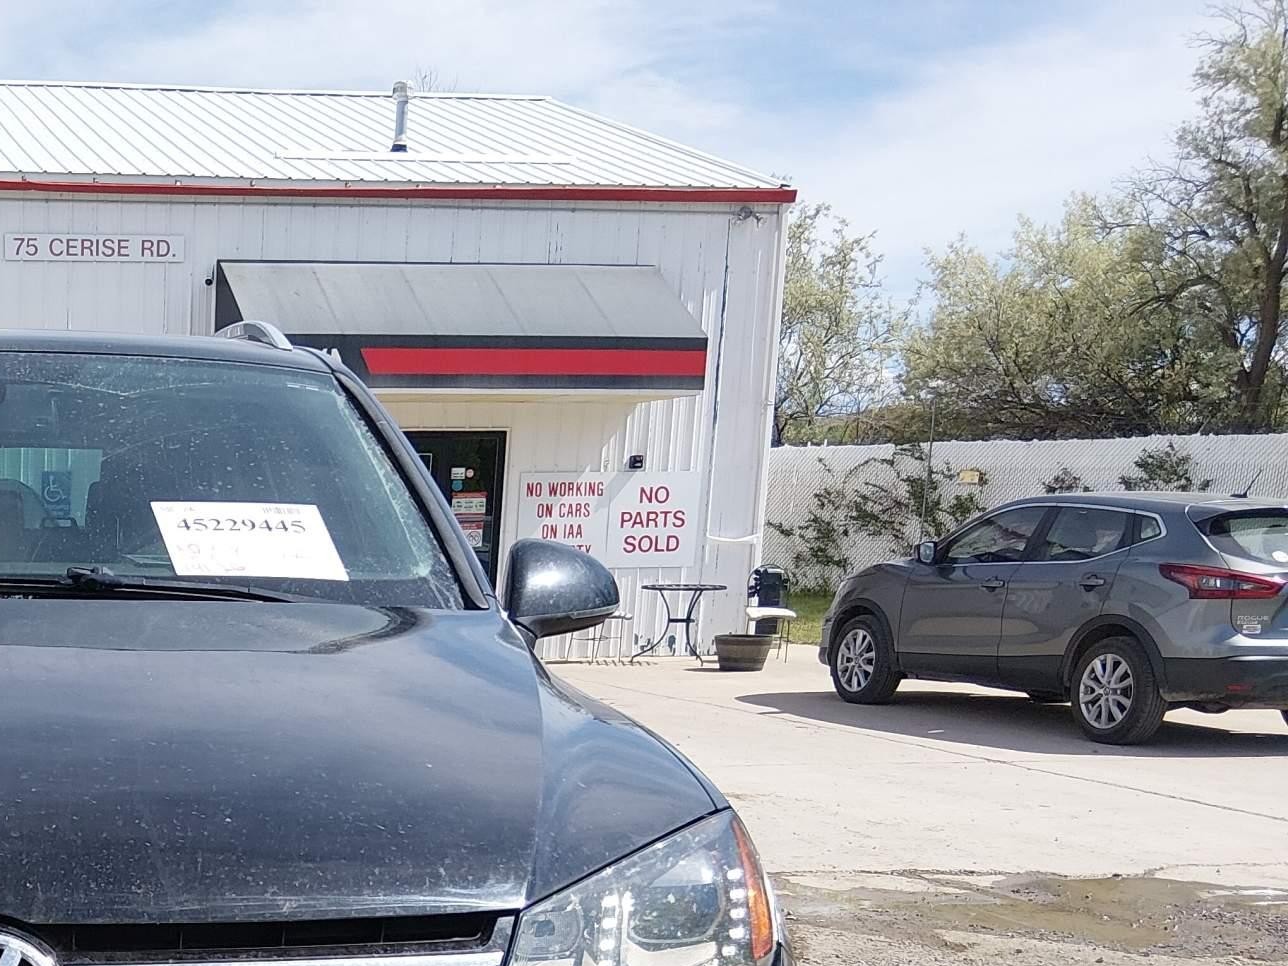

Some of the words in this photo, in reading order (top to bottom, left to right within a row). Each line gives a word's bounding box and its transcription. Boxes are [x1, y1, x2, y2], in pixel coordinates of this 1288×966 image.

[13, 237, 39, 257] 75
[48, 238, 130, 258] CERISE
[141, 239, 177, 258] RD.
[526, 482, 543, 498] NO
[548, 481, 605, 498] WORKING
[639, 486, 671, 504] NO
[536, 503, 554, 519] ON
[558, 502, 592, 519] CARS
[619, 509, 687, 529] PARTS
[176, 517, 306, 535] 45229445
[541, 523, 558, 540] ON
[563, 523, 584, 540] IAA
[622, 534, 681, 554] SOLD
